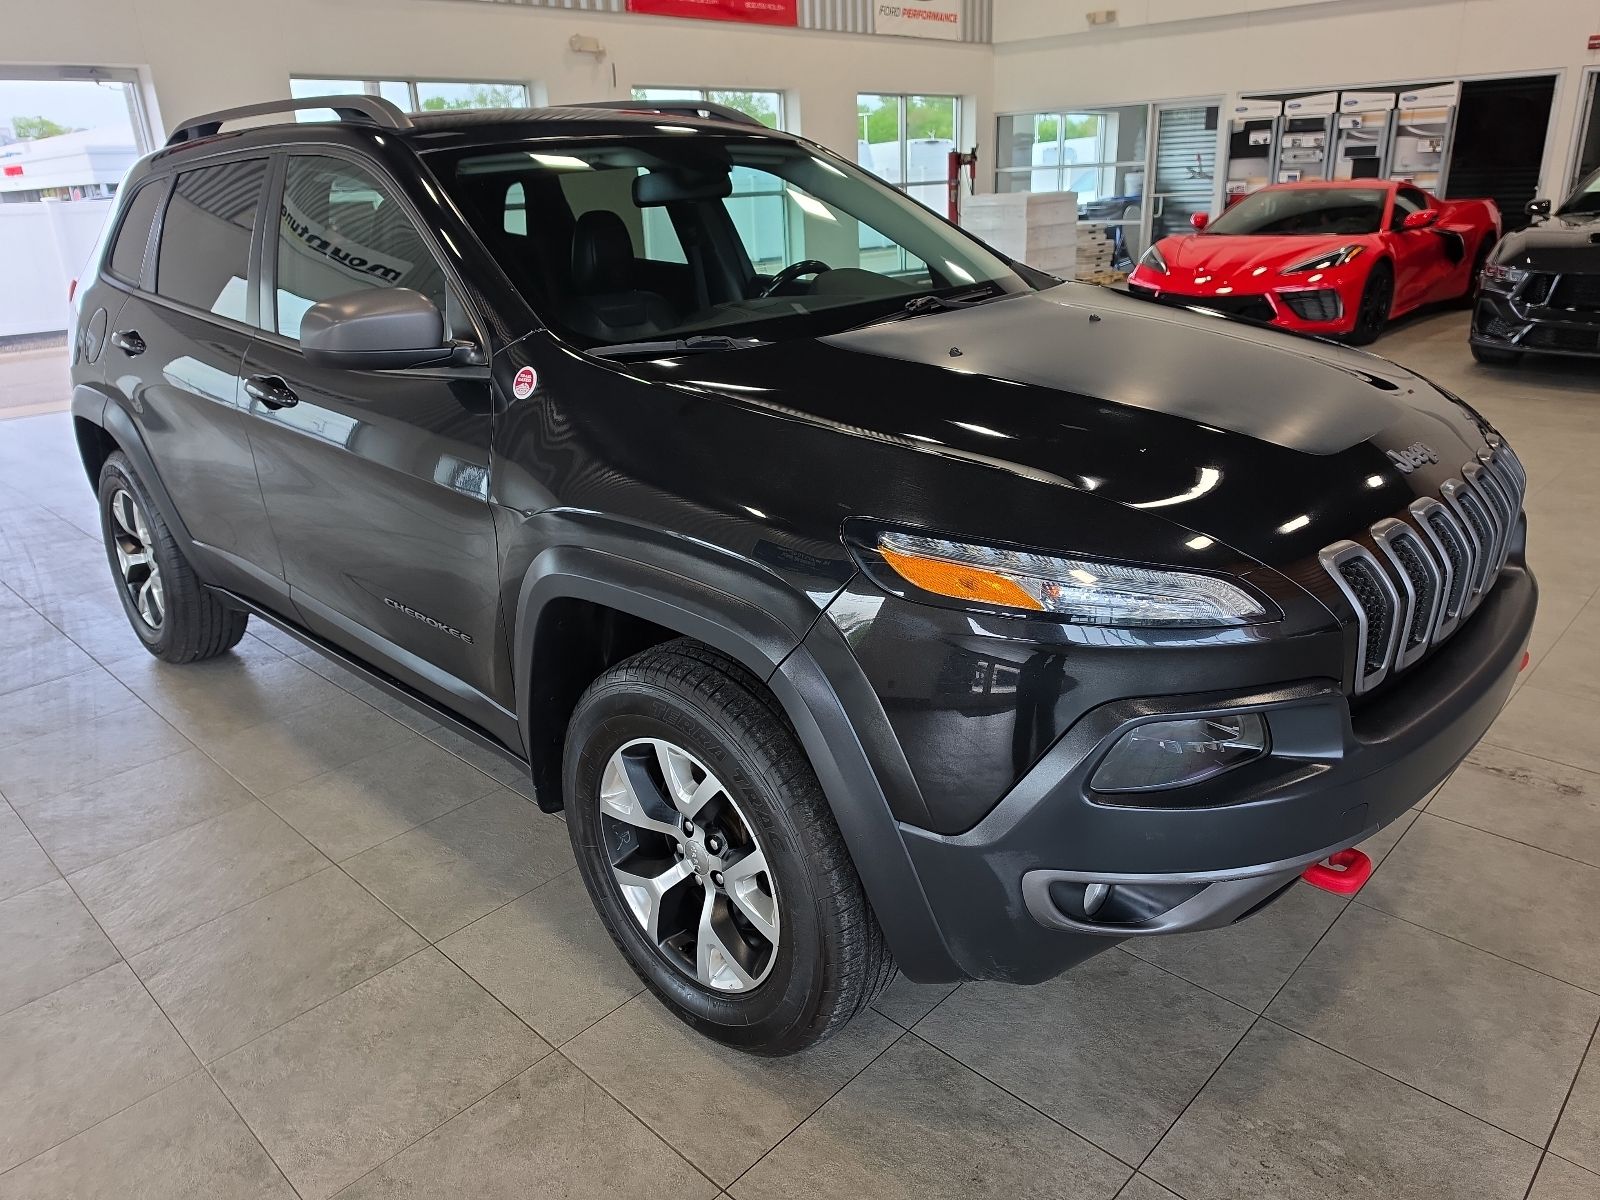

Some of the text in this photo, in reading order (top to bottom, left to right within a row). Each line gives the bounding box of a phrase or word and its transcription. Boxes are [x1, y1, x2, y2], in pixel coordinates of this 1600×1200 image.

[879, 6, 958, 23] FORD PERFORMANCE
[1386, 441, 1440, 473] Jeep
[384, 597, 473, 644] CHEROKEE
